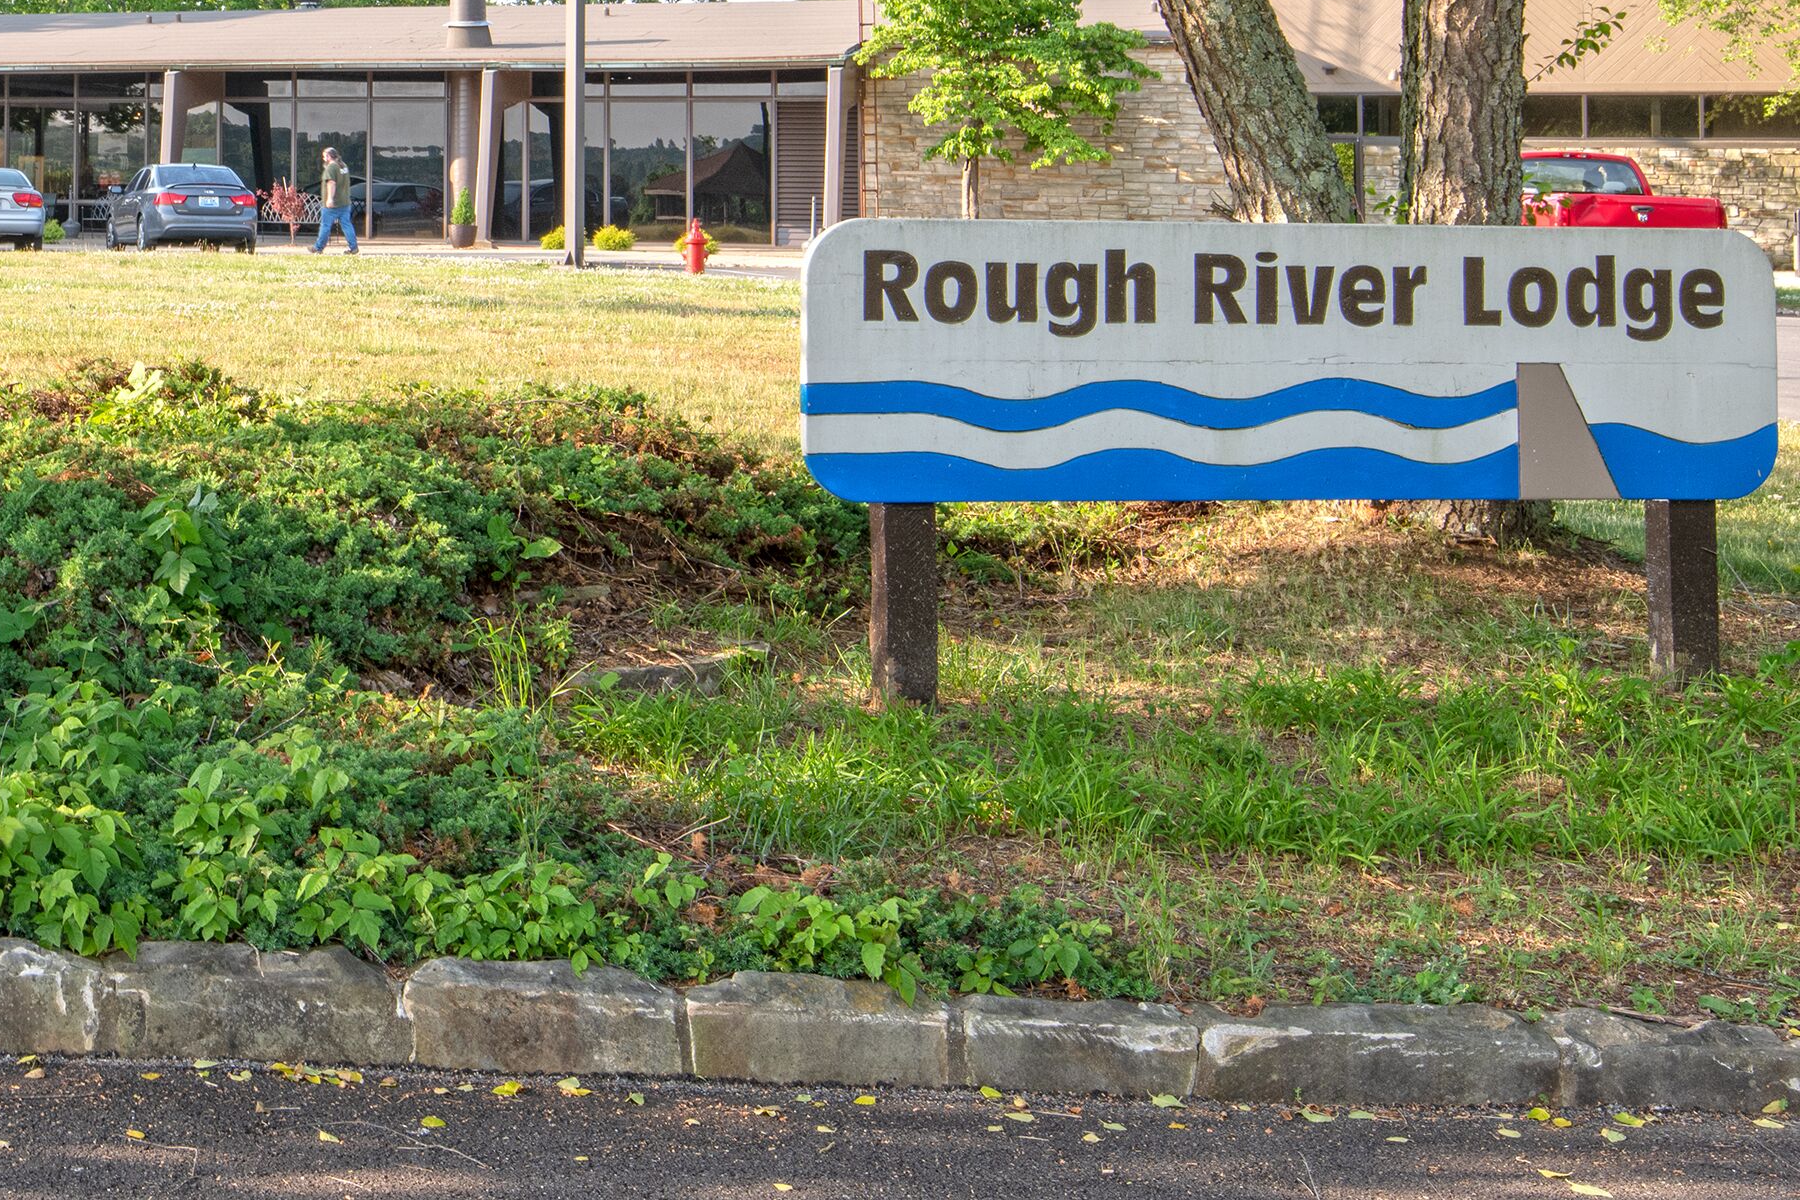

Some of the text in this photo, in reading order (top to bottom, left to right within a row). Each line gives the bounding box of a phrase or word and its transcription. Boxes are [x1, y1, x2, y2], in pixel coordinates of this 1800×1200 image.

[862, 248, 1726, 342] Rough River Lodge
